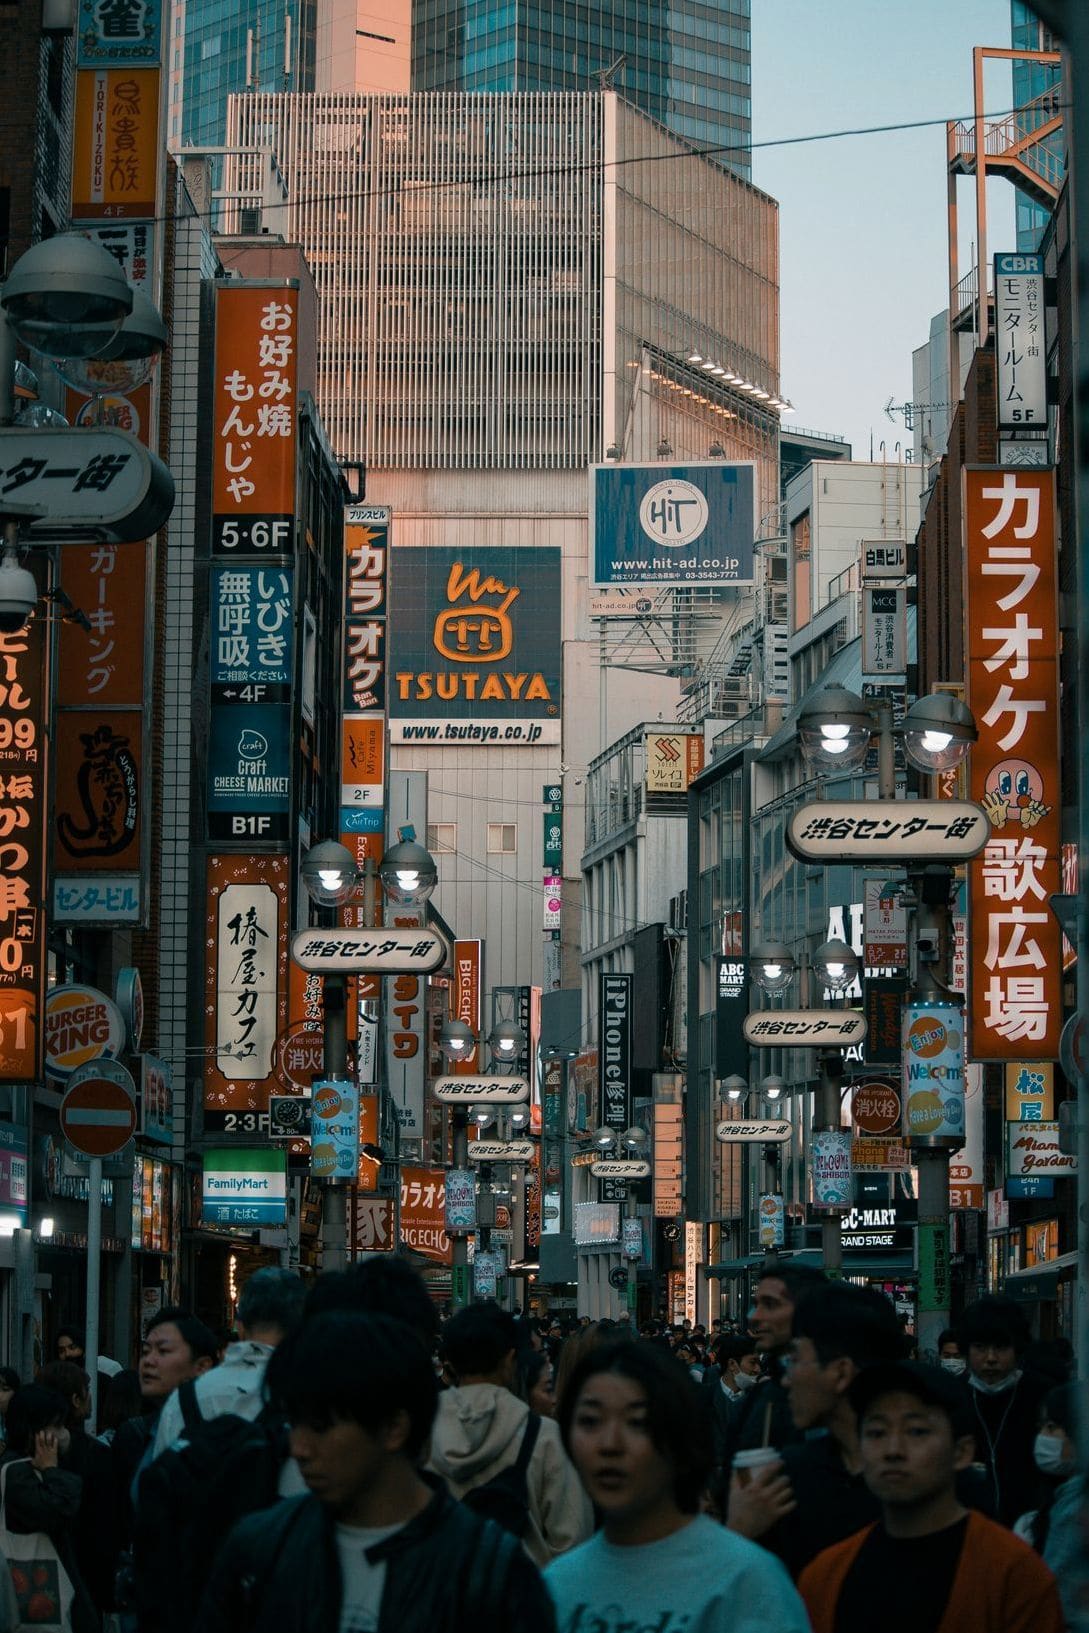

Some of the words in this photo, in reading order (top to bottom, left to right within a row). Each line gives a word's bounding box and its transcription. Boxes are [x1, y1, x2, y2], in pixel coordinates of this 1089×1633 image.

[95, 79, 105, 188] TORIKIZOKU
[1001, 257, 1039, 272] CBR
[1026, 278, 1040, 358] 渋谷センター街
[1004, 278, 1023, 402] モニタールーム
[256, 301, 293, 437] お好み焼
[1012, 409, 1035, 422] 5F
[221, 370, 256, 503] もんじゃ
[0, 454, 131, 494] ター街
[349, 510, 386, 521] プリンスビル
[610, 556, 740, 570] www.hit-ad.co.jp
[866, 548, 905, 566] 白馬ビル
[217, 571, 252, 667] 無呼吸
[256, 570, 292, 667] いびき
[349, 544, 386, 692] カラオケ
[980, 473, 1047, 752] カラオケ
[217, 670, 287, 682] ご相談ください
[238, 684, 267, 703] 4F
[395, 672, 551, 701] TSUTAYA
[402, 723, 543, 742] www.tsutaya.co.jp
[238, 759, 267, 776] Craft
[214, 776, 246, 788] CHEESE
[246, 777, 290, 793] MARKET
[354, 788, 370, 800] 2F
[232, 816, 271, 835] B1F
[350, 816, 379, 829] AirTrip
[800, 817, 978, 840] 渋谷センター街
[56, 887, 138, 912] センタービル
[301, 941, 435, 957] 渋谷センター街
[982, 836, 1050, 1043] 歌広場
[459, 959, 472, 988] BIG
[720, 963, 745, 976] ABC
[720, 976, 745, 985] MART
[46, 1004, 107, 1032] URGER
[751, 1020, 860, 1035] 渋谷センター街
[910, 1026, 946, 1051] Enjoy
[438, 1083, 524, 1095] 渋谷センター街
[856, 1099, 896, 1119] 消火栓
[719, 1125, 788, 1136] 渋谷センター街
[207, 1178, 269, 1192] FamilyMart
[217, 1206, 230, 1221] 酒
[233, 1207, 260, 1220] たばこ
[418, 1229, 450, 1252] ECHO
[866, 1234, 894, 1246] STAGE
